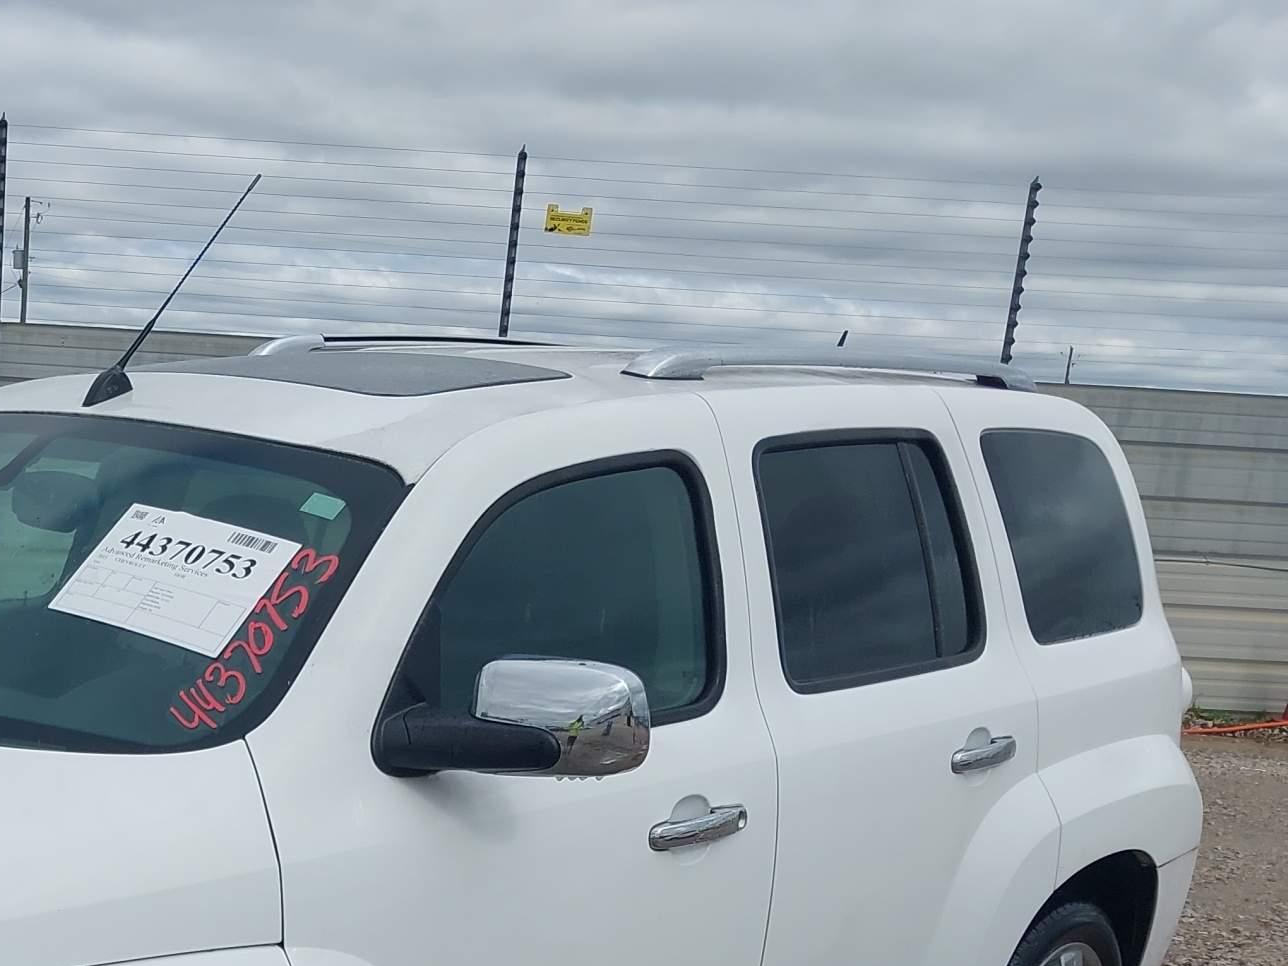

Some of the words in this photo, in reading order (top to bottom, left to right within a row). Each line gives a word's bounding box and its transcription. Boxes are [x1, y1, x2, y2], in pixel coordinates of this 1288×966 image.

[120, 530, 257, 580] 44370753
[135, 552, 179, 570] Remarketing
[179, 565, 208, 577] Services
[169, 548, 340, 730] 44370753
